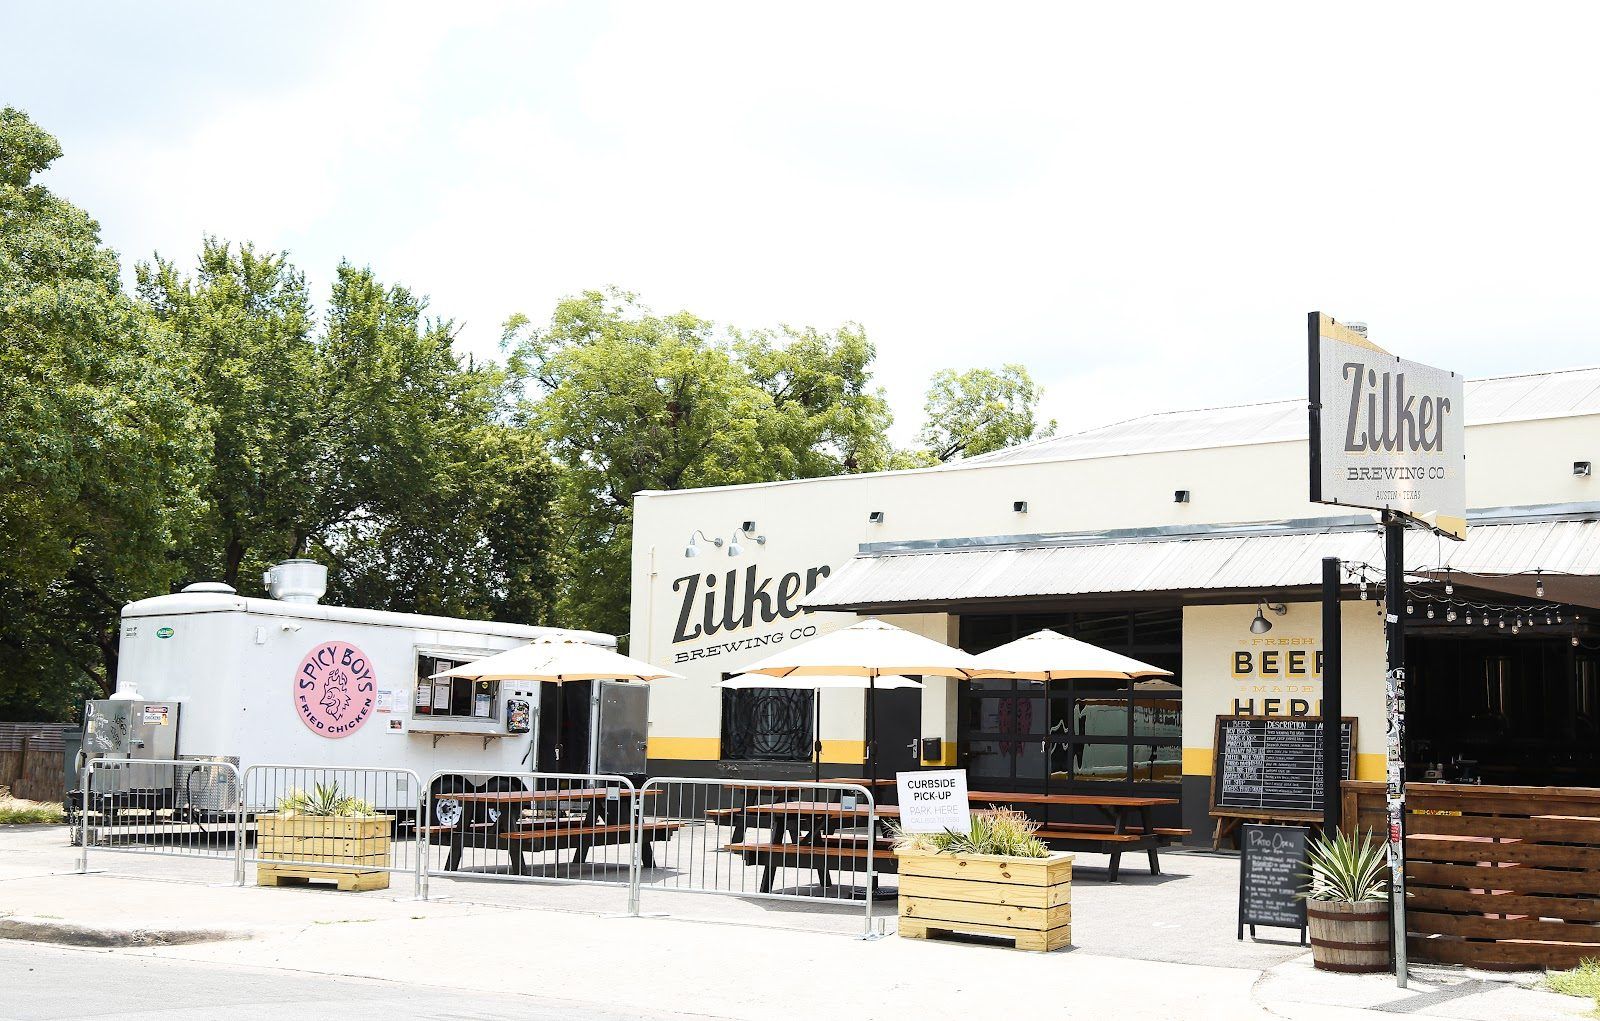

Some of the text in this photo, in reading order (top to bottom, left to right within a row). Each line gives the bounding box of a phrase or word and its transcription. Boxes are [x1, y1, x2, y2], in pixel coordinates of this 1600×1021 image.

[1342, 362, 1451, 452] Zilker
[1347, 466, 1425, 480] BREWING
[1375, 490, 1421, 500] AUSTIN TEXAS
[672, 564, 831, 644] Zilker
[674, 632, 784, 664] BREWING
[1251, 638, 1315, 646] FRESH
[299, 645, 373, 693] SPICY BOYS
[1252, 685, 1314, 693] MADE
[299, 694, 324, 730] FRIED
[327, 698, 372, 733] CHICKEN
[1232, 720, 1251, 728] BEER
[1266, 720, 1307, 730] DESCRIPTION
[907, 778, 956, 789] CURBSIDE
[913, 791, 952, 801] PICK-UP
[909, 804, 959, 816] PARK HERE
